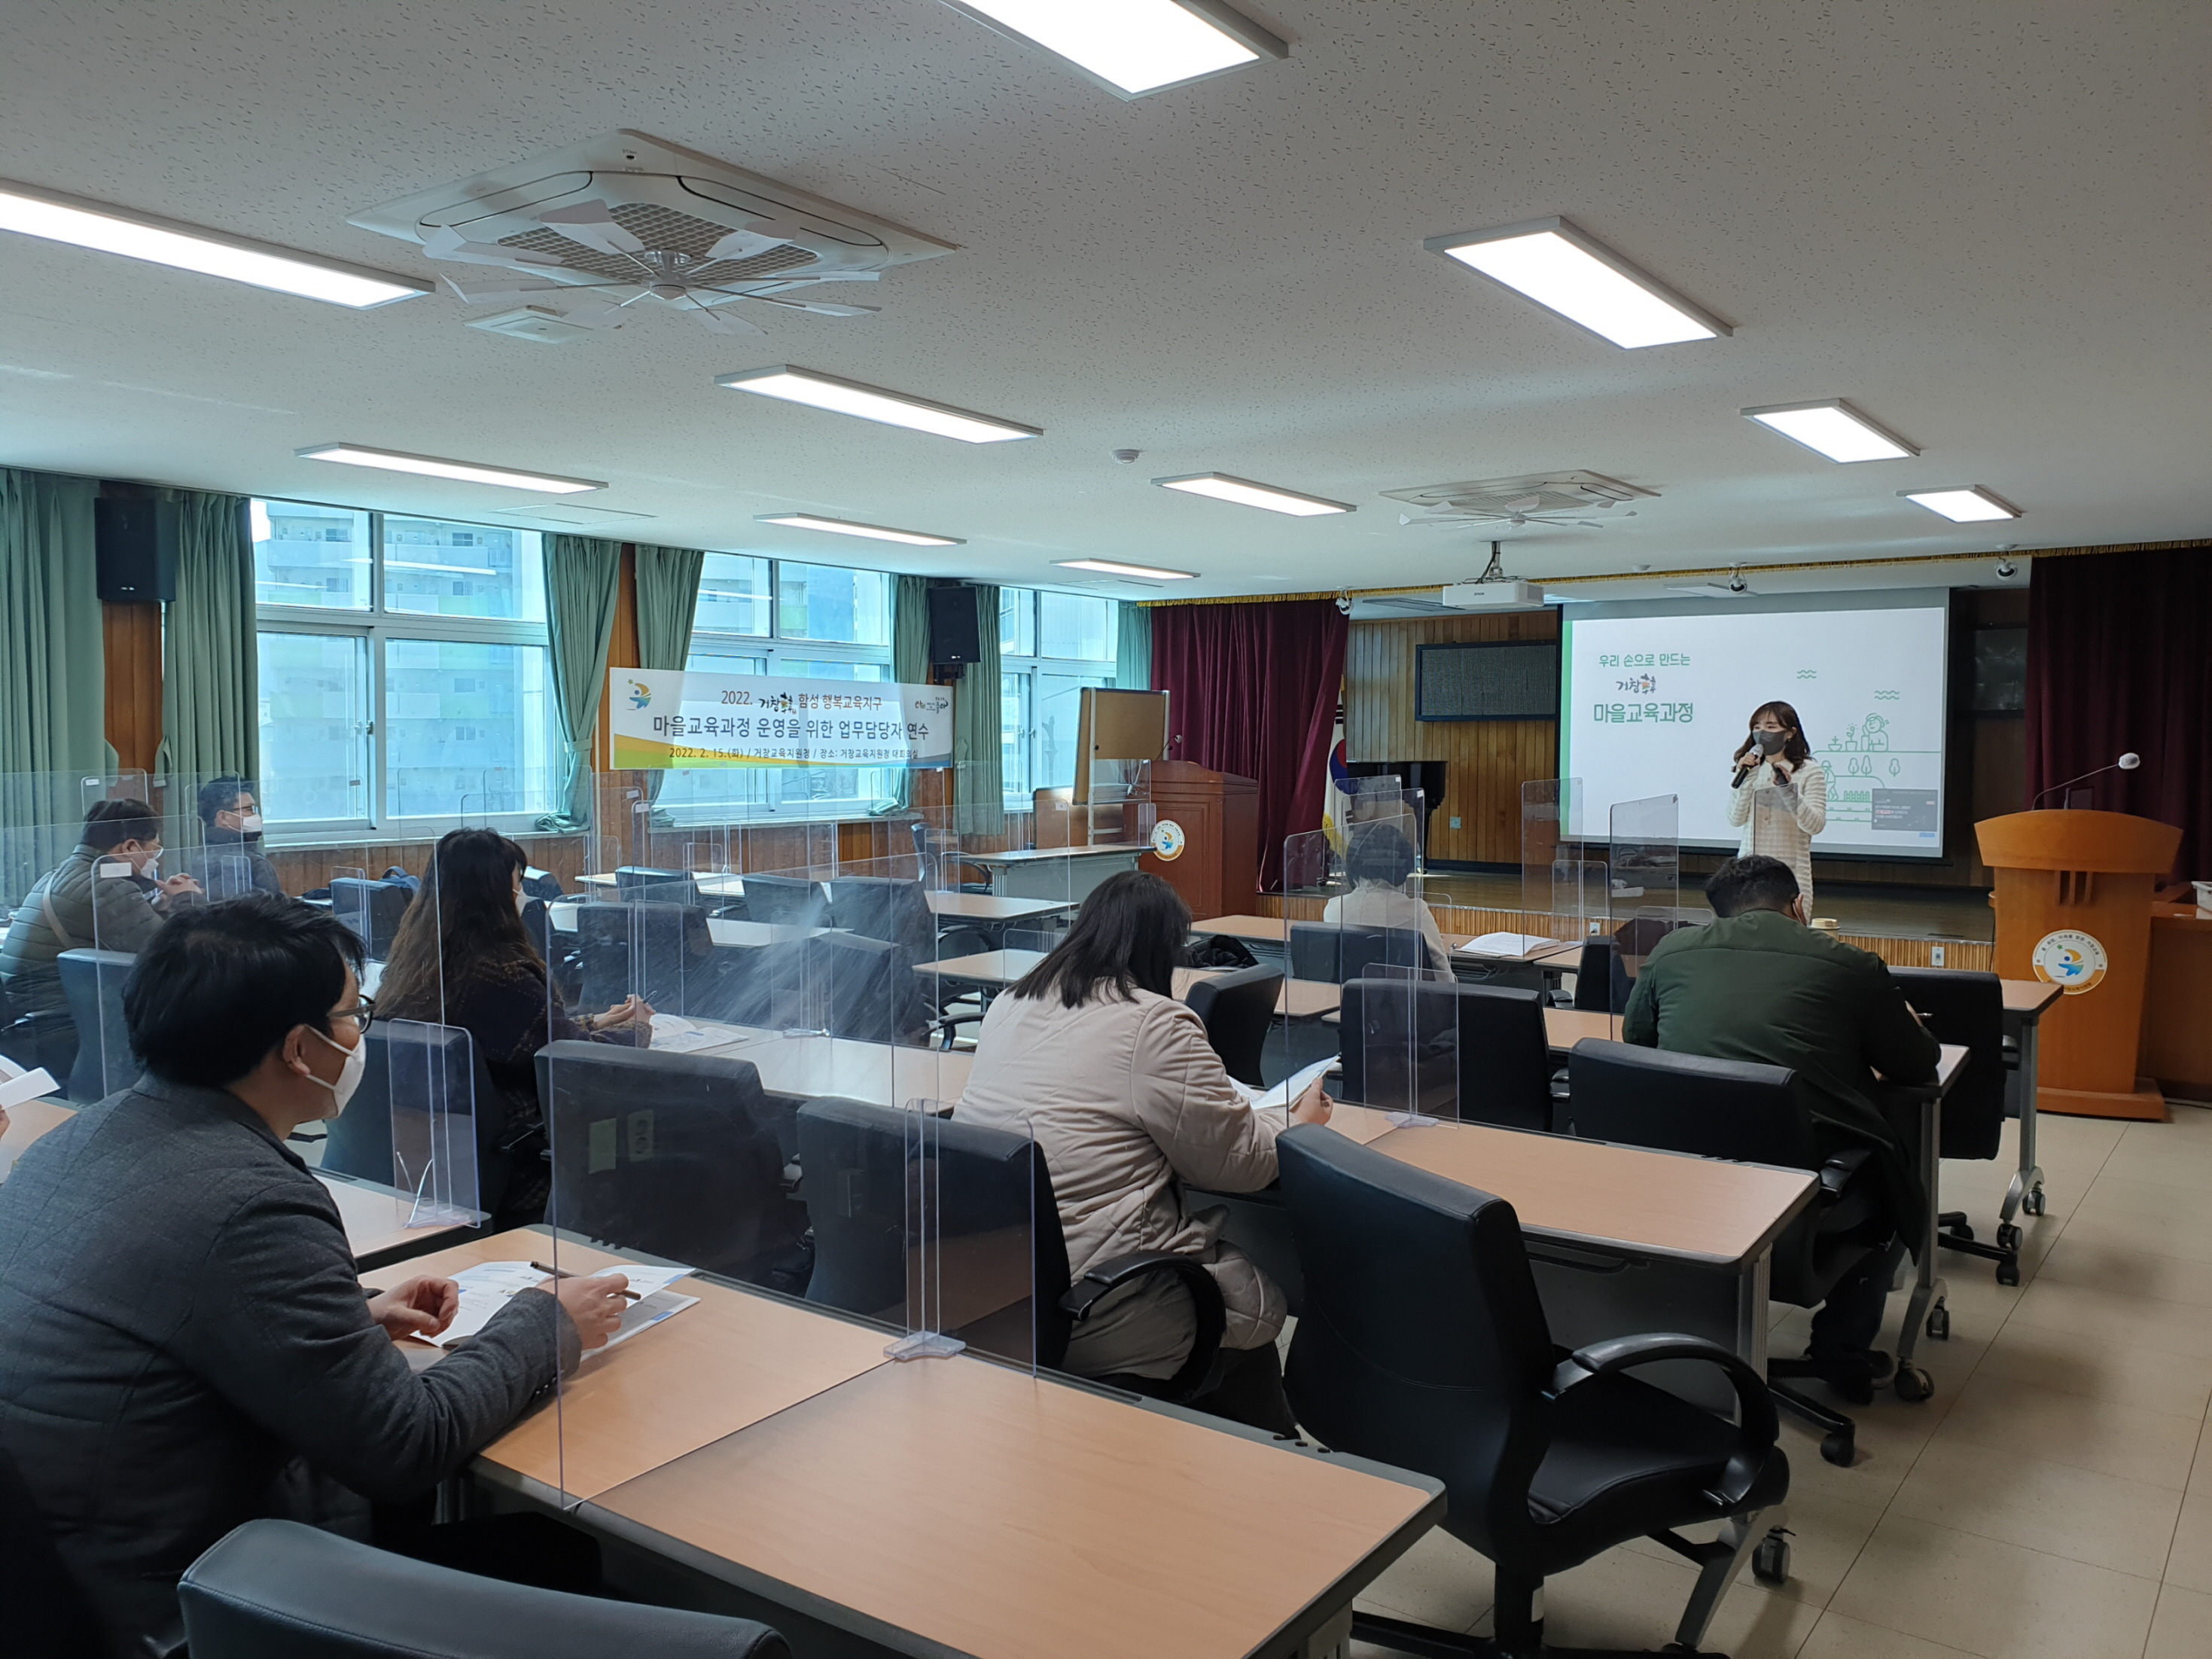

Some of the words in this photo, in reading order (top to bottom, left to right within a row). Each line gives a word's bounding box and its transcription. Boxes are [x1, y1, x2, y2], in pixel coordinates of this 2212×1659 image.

[1598, 654, 1619, 668] 우리
[1623, 654, 1655, 667] 손으로
[1659, 653, 1691, 666] 만드는
[721, 690, 753, 706] 2022.
[798, 693, 819, 709] 함성
[822, 694, 882, 711] 행복교육지구
[1593, 702, 1694, 724] 마을교육과정
[653, 715, 751, 738] 마을교육과정
[756, 717, 801, 739] 운영을
[806, 719, 833, 740] 위한
[839, 720, 903, 740] 업무담당자
[907, 722, 929, 740] 연수
[669, 747, 696, 758] 2022.
[699, 748, 709, 758] 2.
[746, 748, 751, 759] /
[754, 747, 810, 759] 거창교육지원청
[812, 748, 817, 759] /
[820, 748, 838, 760] 장소:
[840, 749, 890, 760] 거창교육지원청
